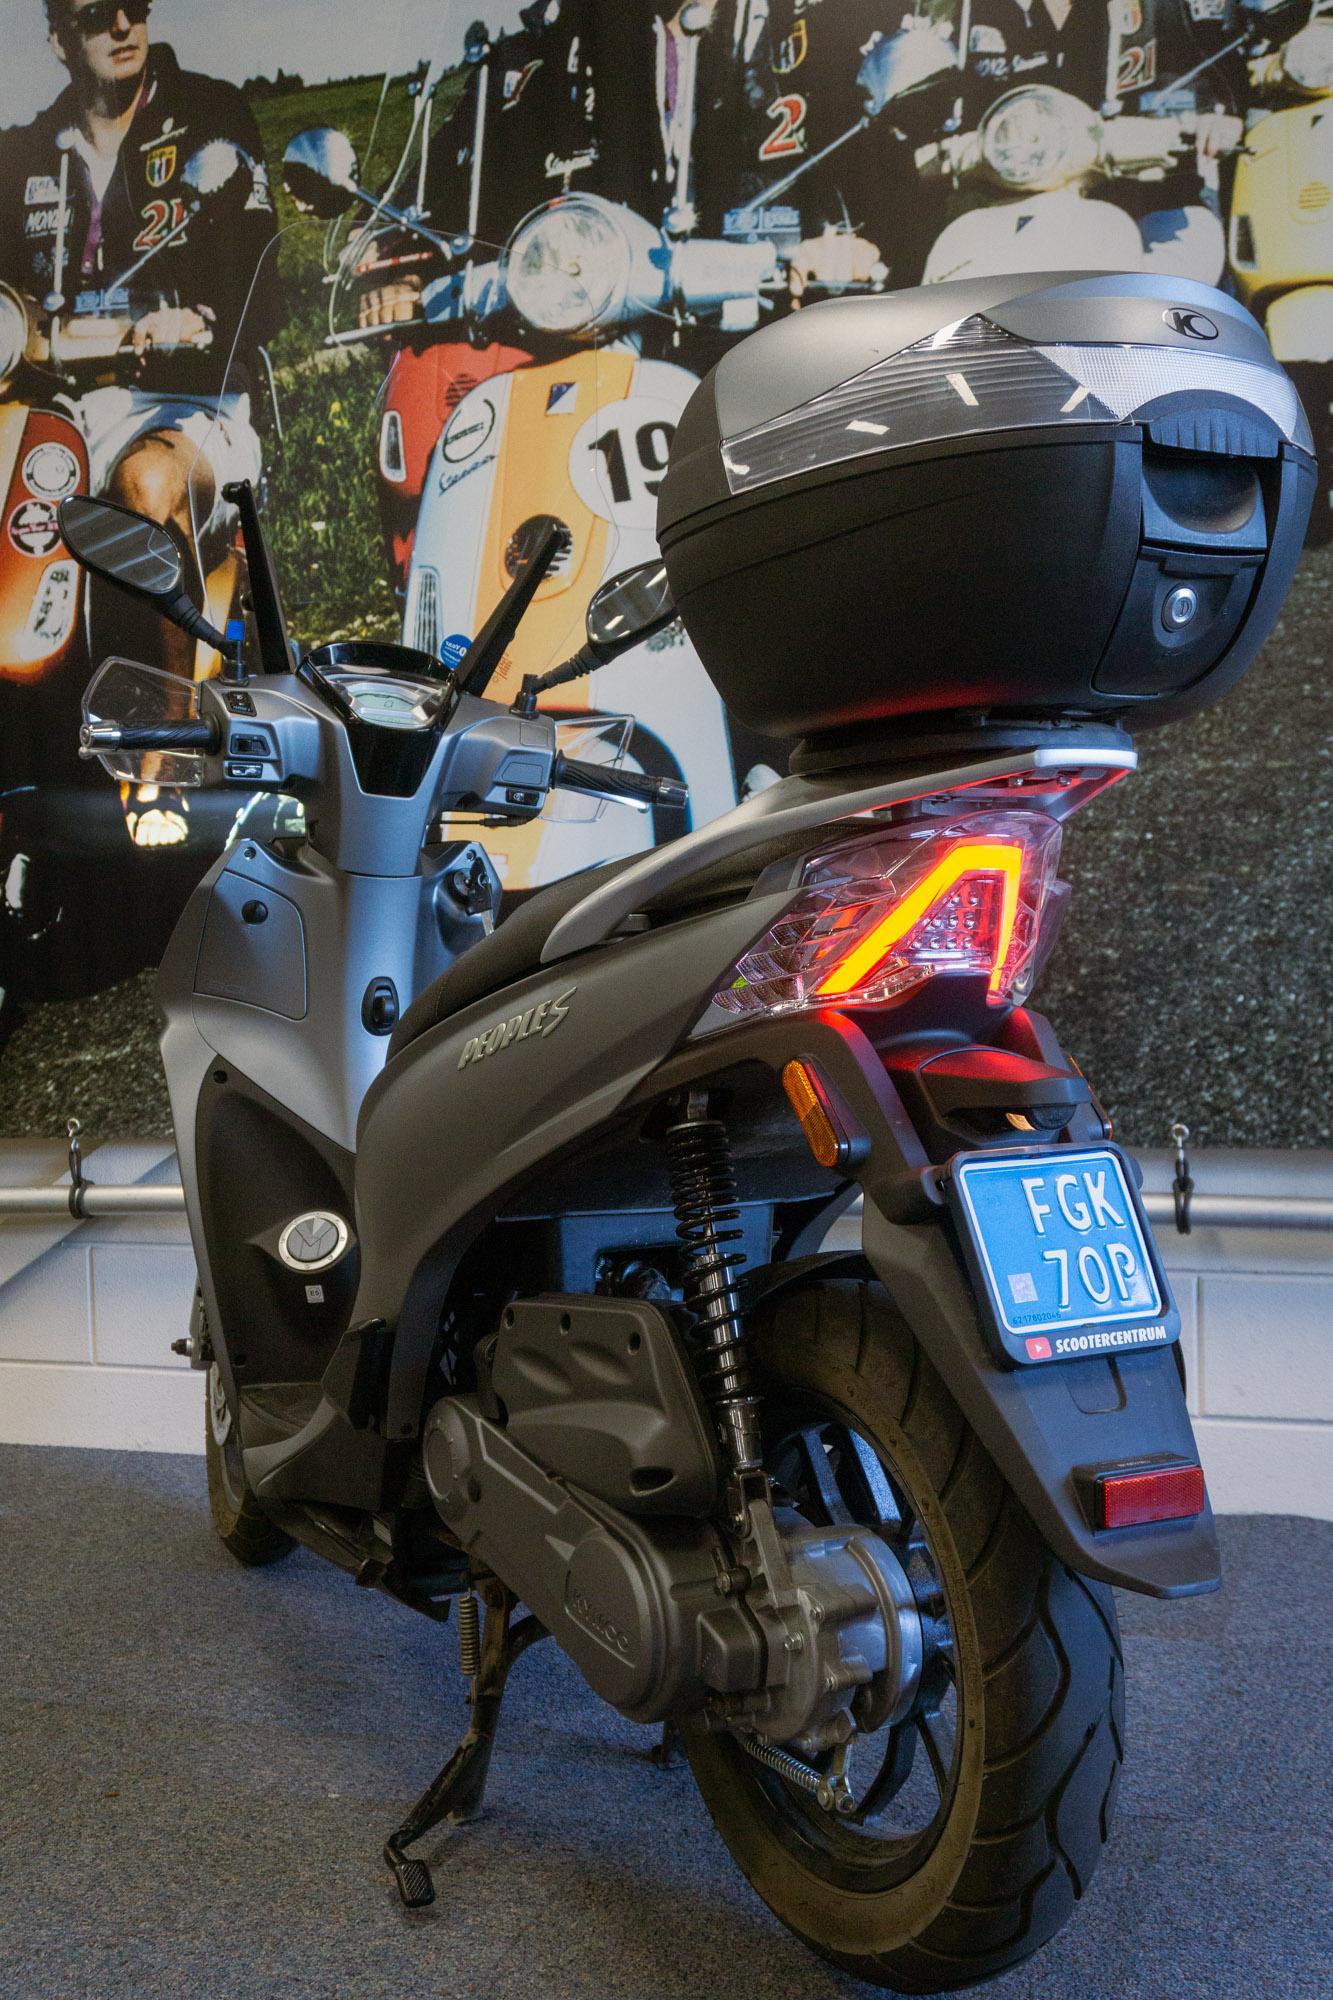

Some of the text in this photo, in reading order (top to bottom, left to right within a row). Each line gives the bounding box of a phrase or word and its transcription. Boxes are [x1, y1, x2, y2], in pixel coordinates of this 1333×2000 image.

[132, 198, 188, 251] 21
[588, 421, 678, 503] 19
[1021, 1171, 1125, 1235] FGK
[1043, 1243, 1136, 1307] 70P
[1056, 1326, 1167, 1353] SCOOTERCENTRUM
